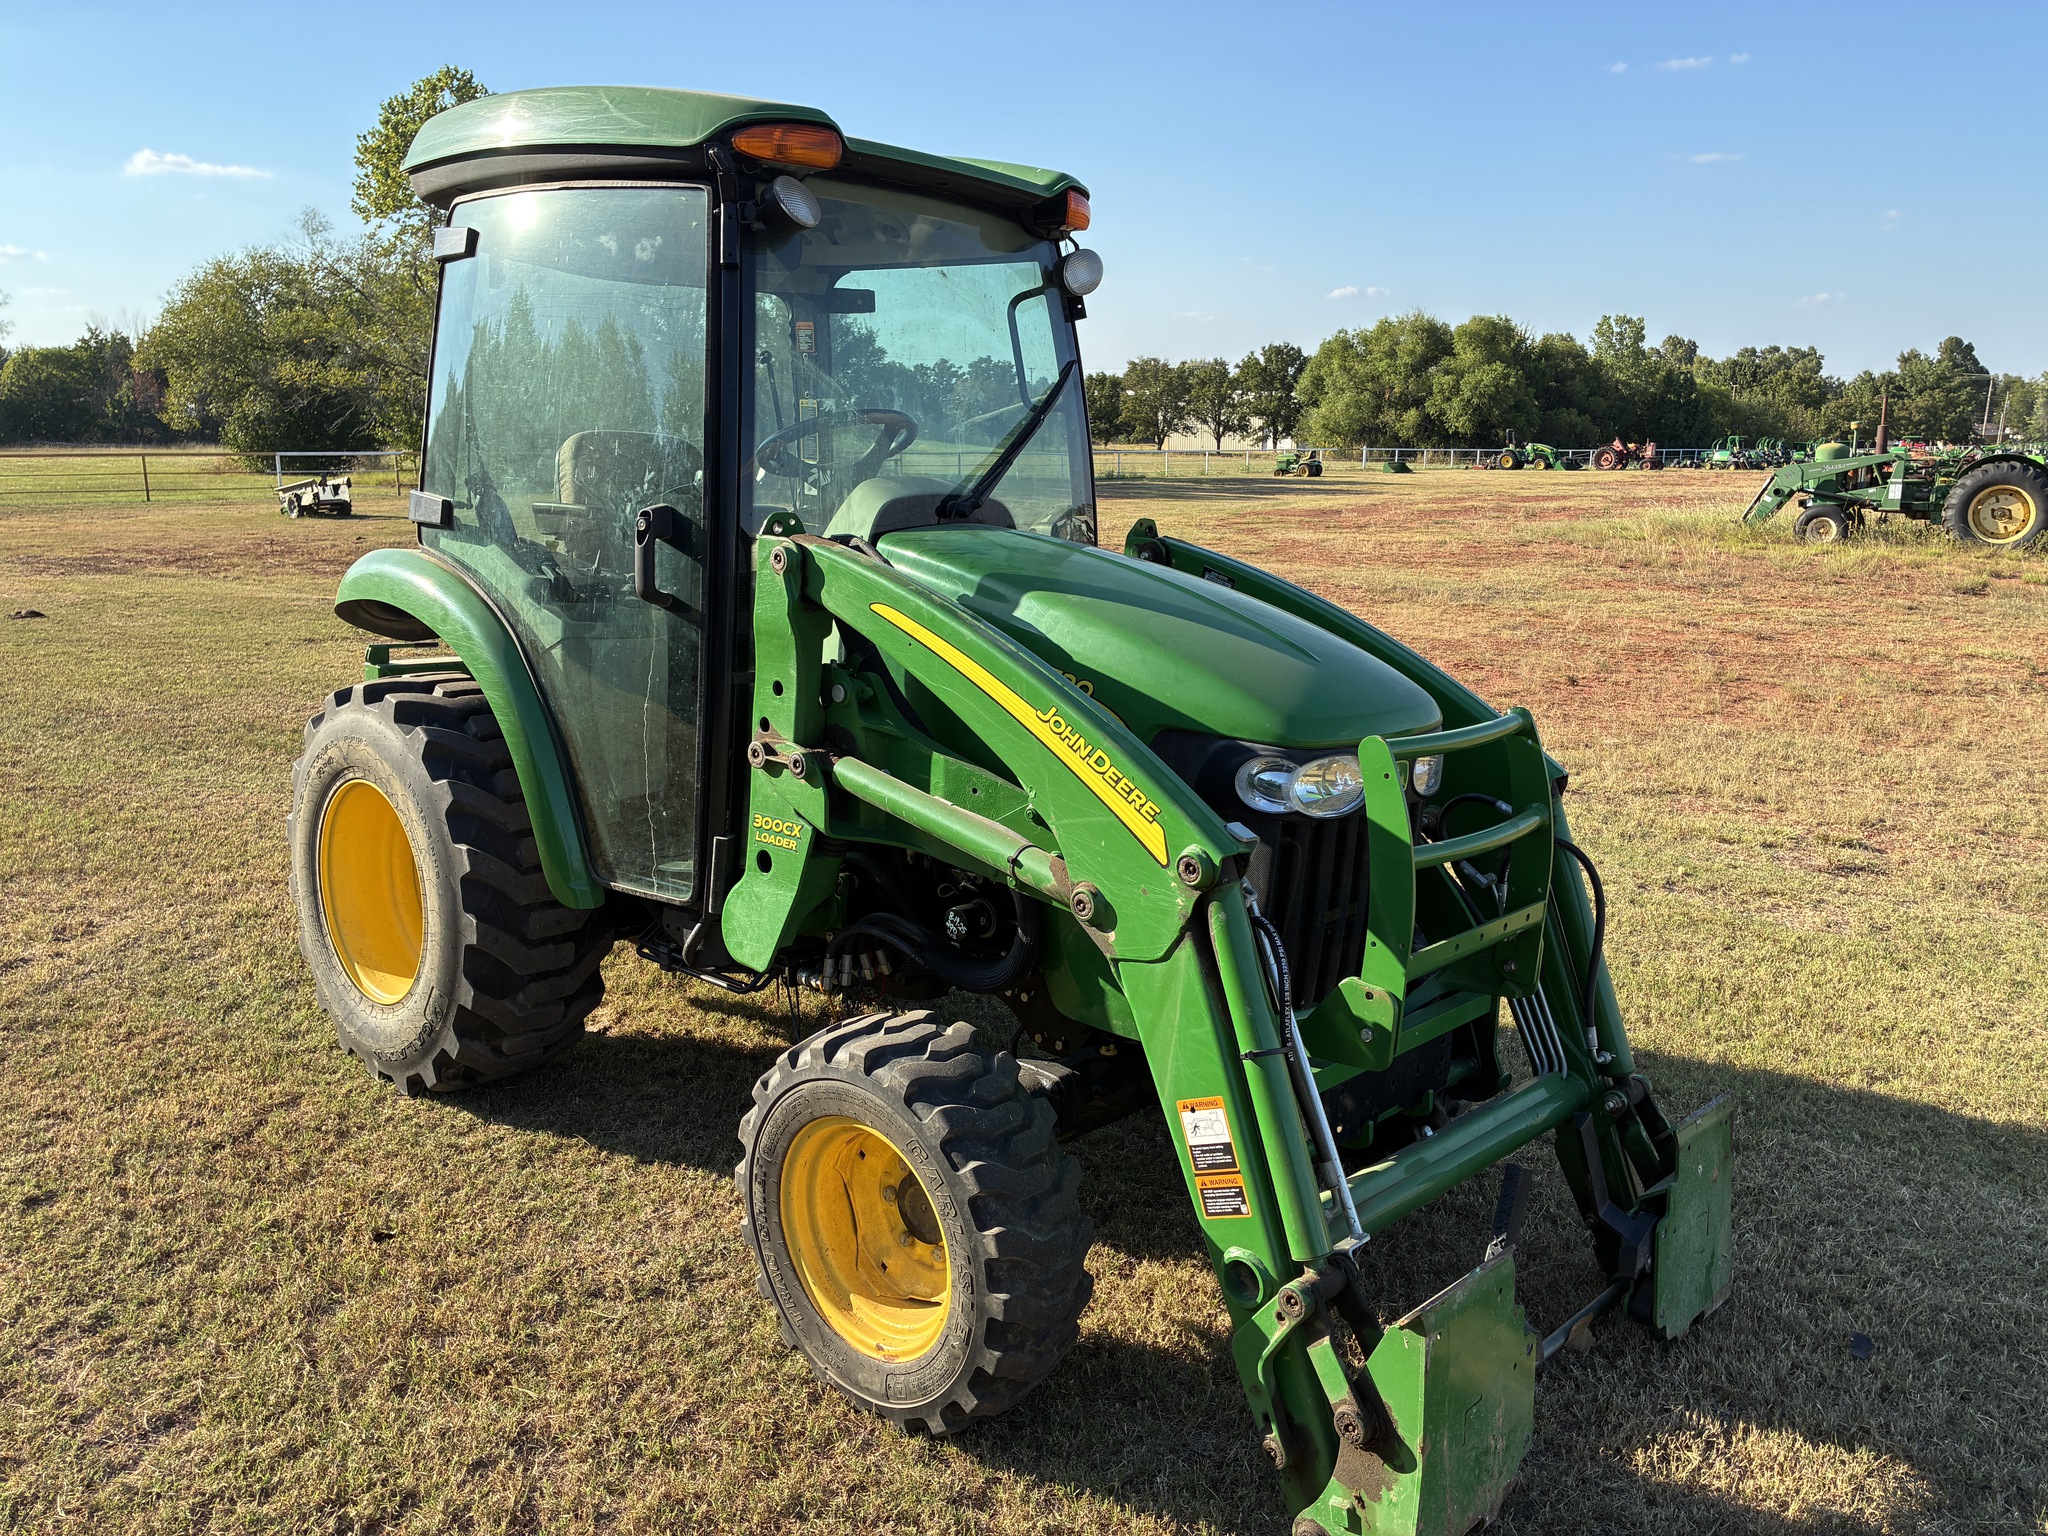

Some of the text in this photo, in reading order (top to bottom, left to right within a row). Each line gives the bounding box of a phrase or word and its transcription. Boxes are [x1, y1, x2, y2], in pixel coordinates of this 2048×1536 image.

[1036, 705, 1162, 824] JOHN DEERE
[753, 813, 804, 839] 300CX
[755, 830, 797, 851] LOADER
[1188, 1100, 1219, 1109] WARNING
[1208, 1178, 1238, 1187] WARNING
[906, 1138, 975, 1347] CARLISLE
